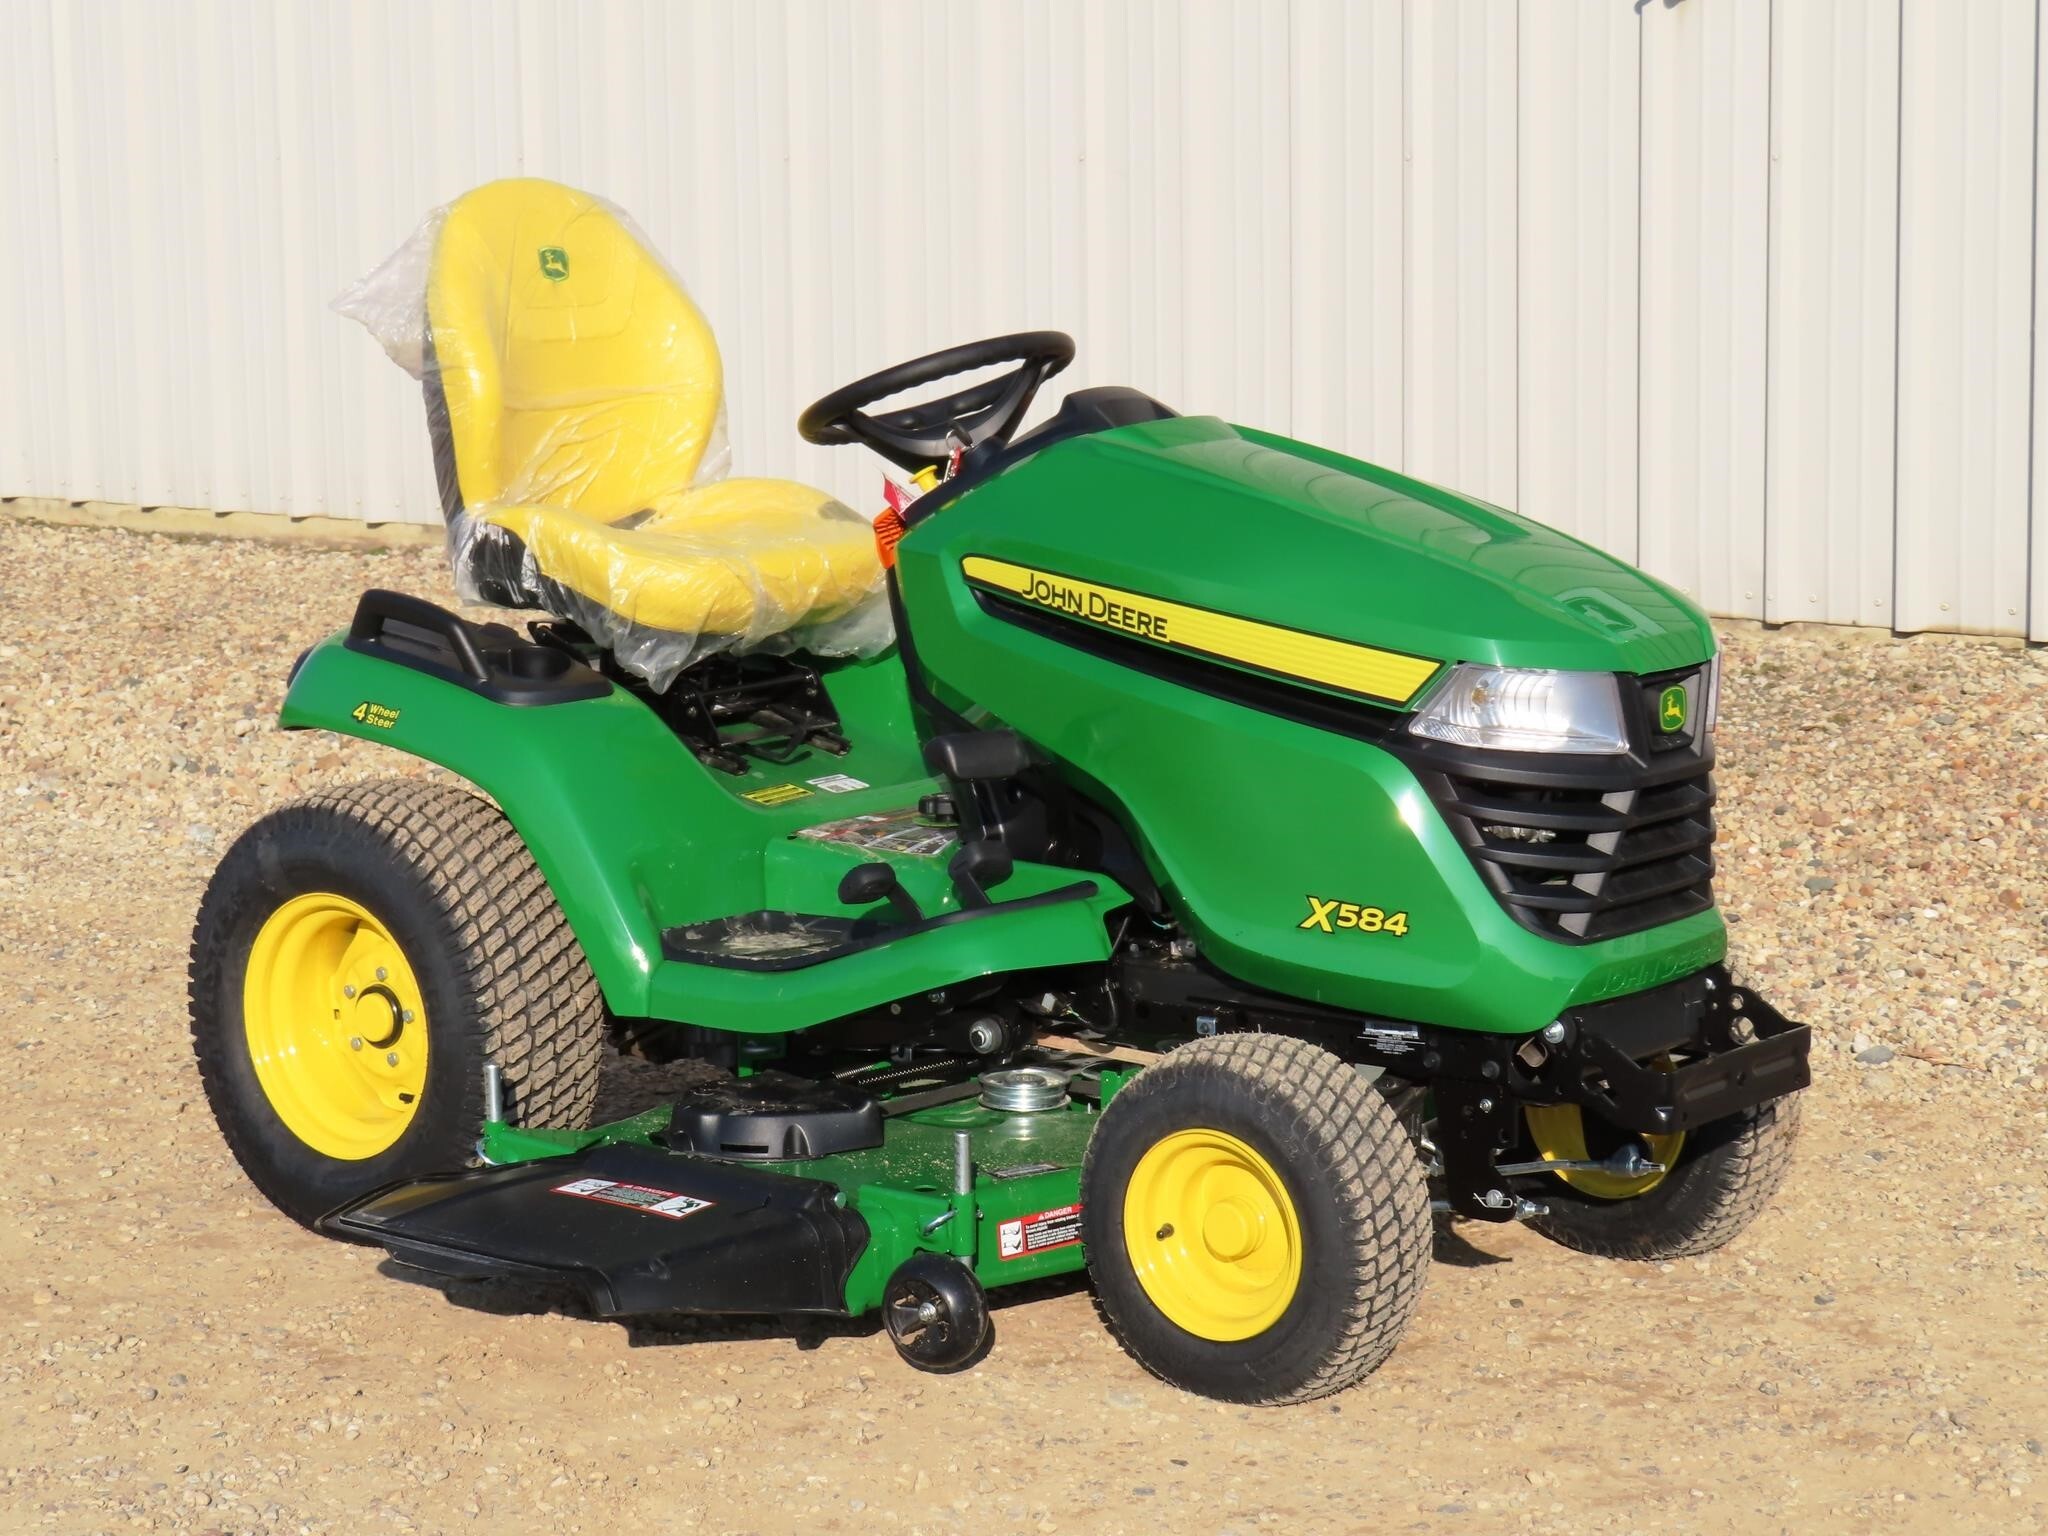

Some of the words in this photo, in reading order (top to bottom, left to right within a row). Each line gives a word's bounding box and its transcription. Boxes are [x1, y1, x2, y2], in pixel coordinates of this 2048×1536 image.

[1022, 572, 1083, 613] JOHN
[1089, 591, 1168, 639] DEERE
[352, 702, 369, 721] 4
[369, 703, 400, 720] Wheel
[366, 713, 395, 729] Steer
[1298, 896, 1409, 937] X584
[1044, 1206, 1072, 1219] DANGER
